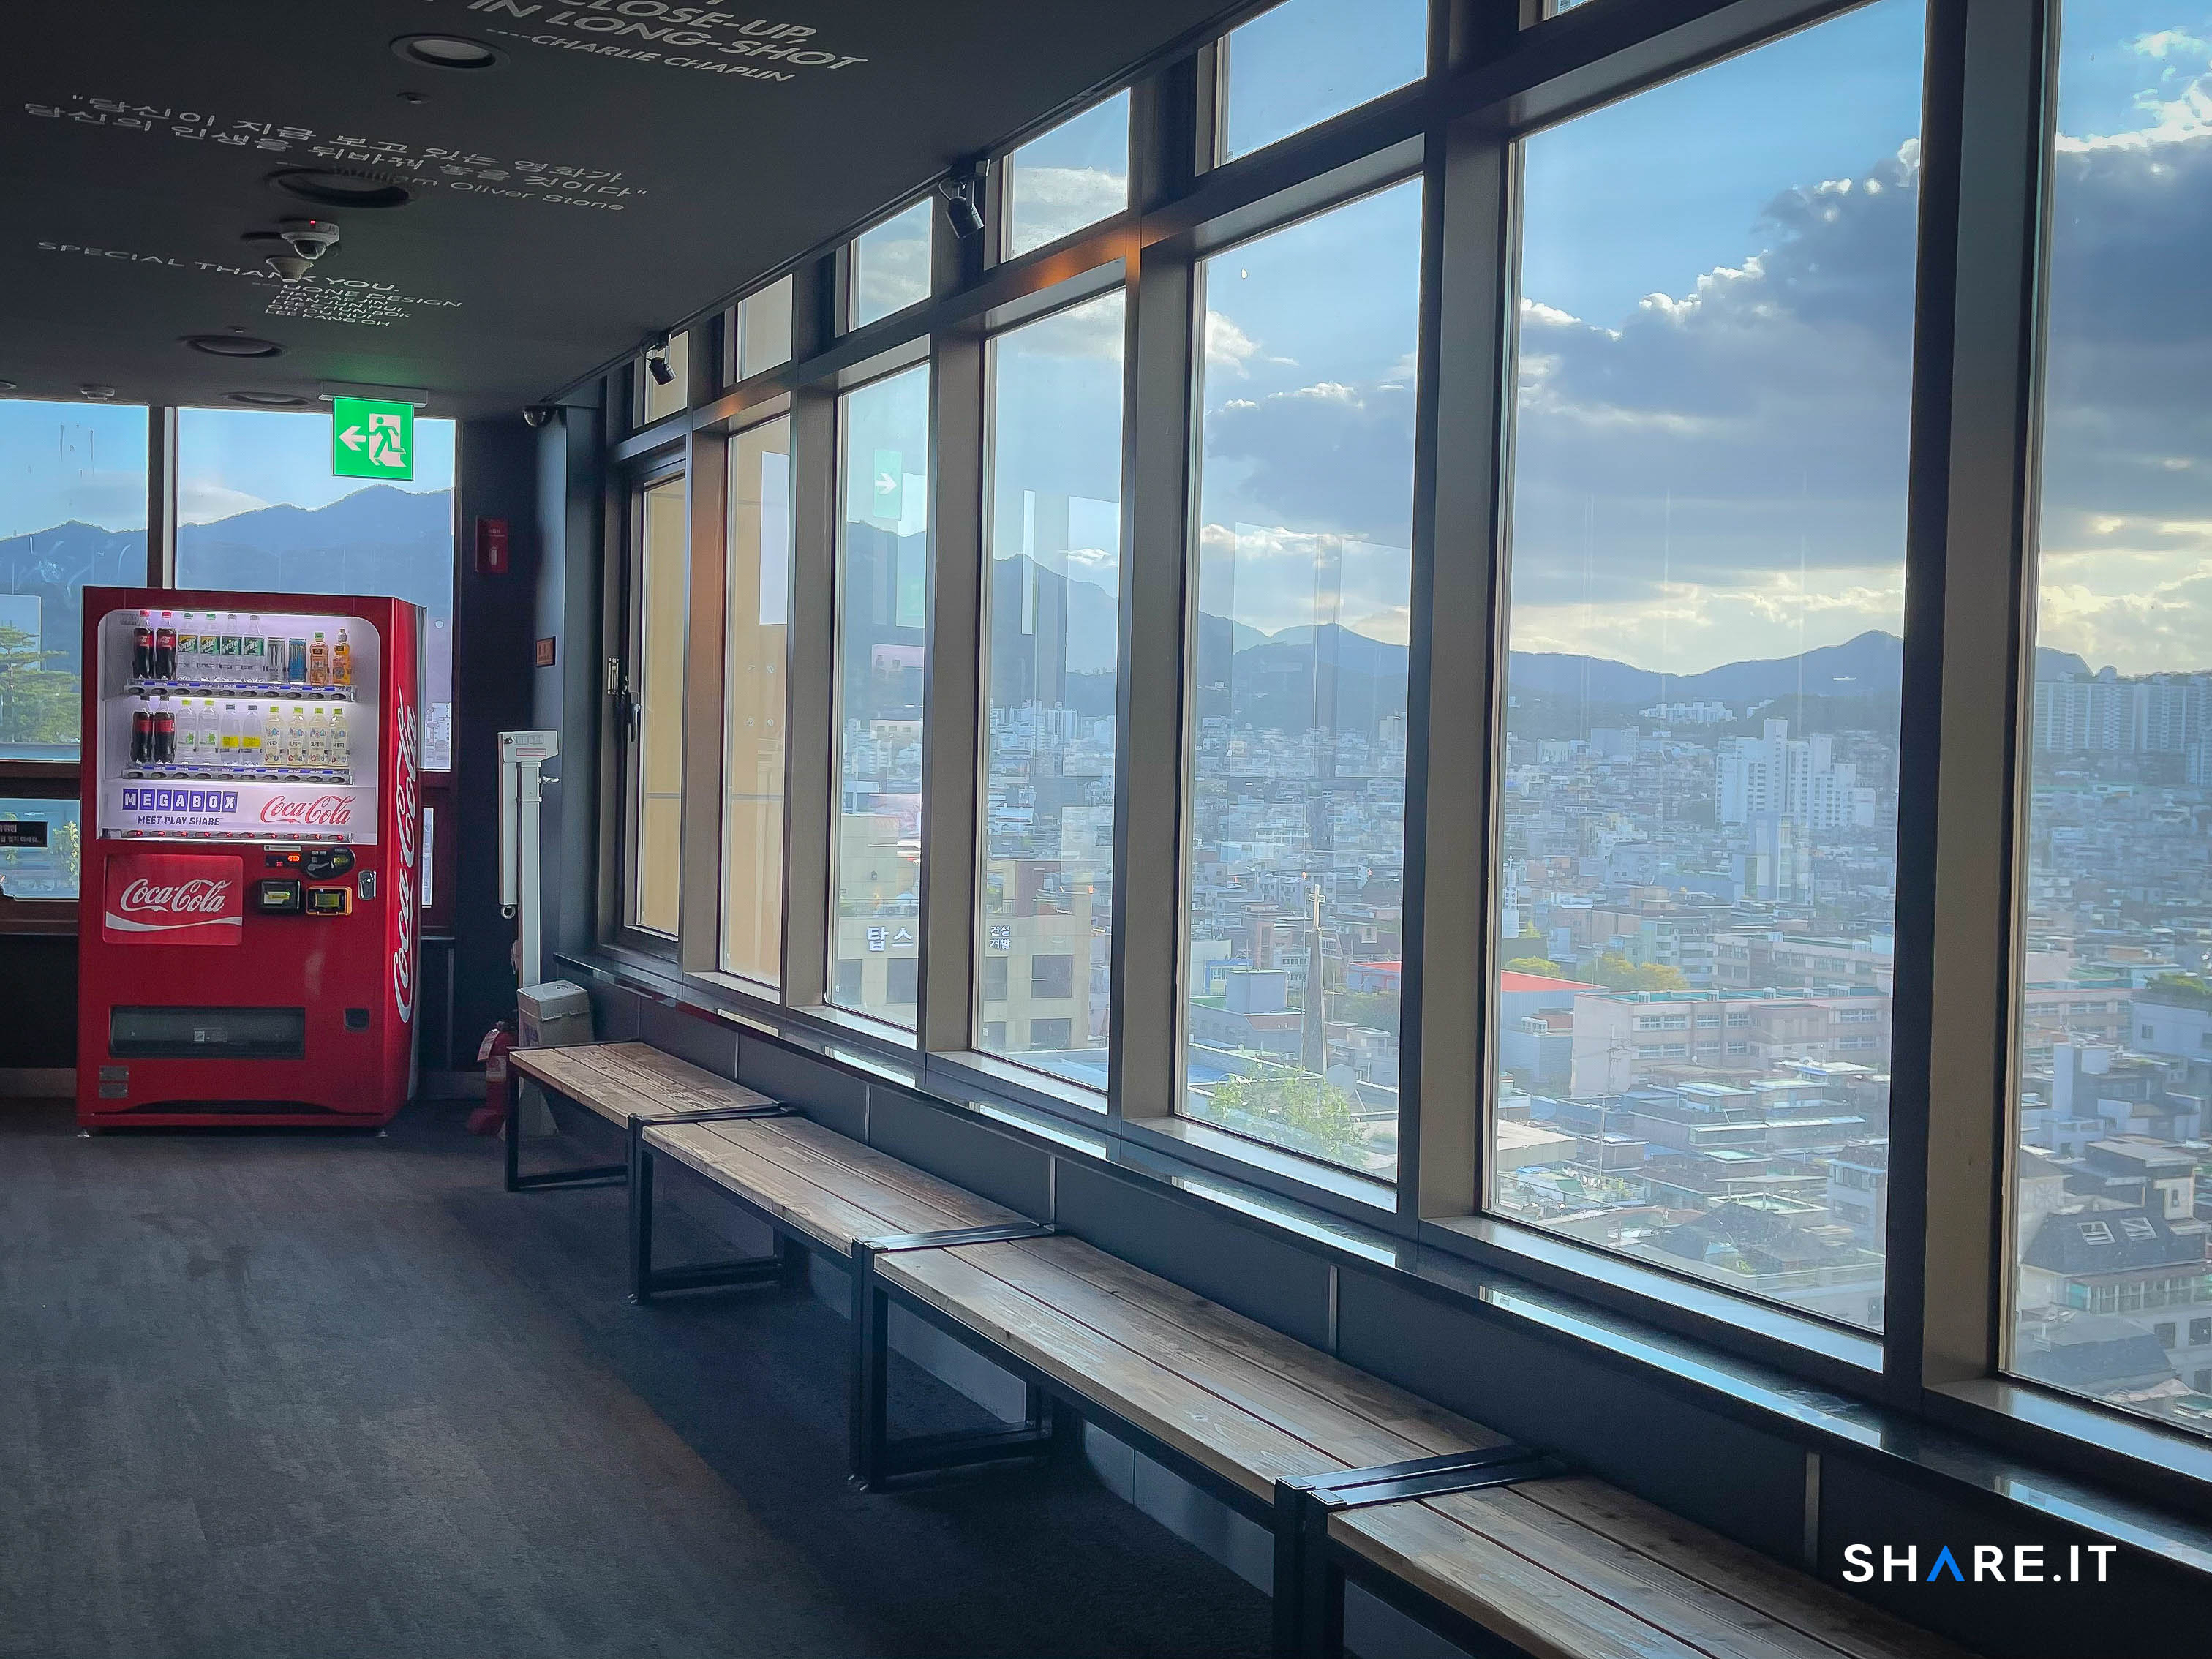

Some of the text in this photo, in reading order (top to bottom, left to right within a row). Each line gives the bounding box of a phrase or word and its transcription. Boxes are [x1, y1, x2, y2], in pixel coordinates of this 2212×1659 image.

[546, 11, 868, 69] LONG-SHOT
[663, 57, 796, 81] CHAPLIN
[25, 103, 151, 131] 당신의
[172, 126, 293, 152] 인생을
[308, 146, 424, 170] 뒤바꿔
[233, 121, 316, 140] 지금
[329, 135, 407, 154] 보고
[423, 148, 499, 165] 있는
[515, 160, 622, 182] 영화가
[451, 181, 535, 198] Oliver
[543, 194, 624, 210] Stone
[38, 241, 184, 267] SPECIAL
[326, 276, 399, 292] YOU.
[366, 293, 462, 307] DESIGN
[124, 791, 236, 810] MEGABOX
[260, 795, 356, 824] Coca-Cola
[137, 816, 219, 826] MEET PLAY SHARE
[394, 684, 417, 1023] Coca-Cola
[120, 878, 233, 913] Coca-Cola
